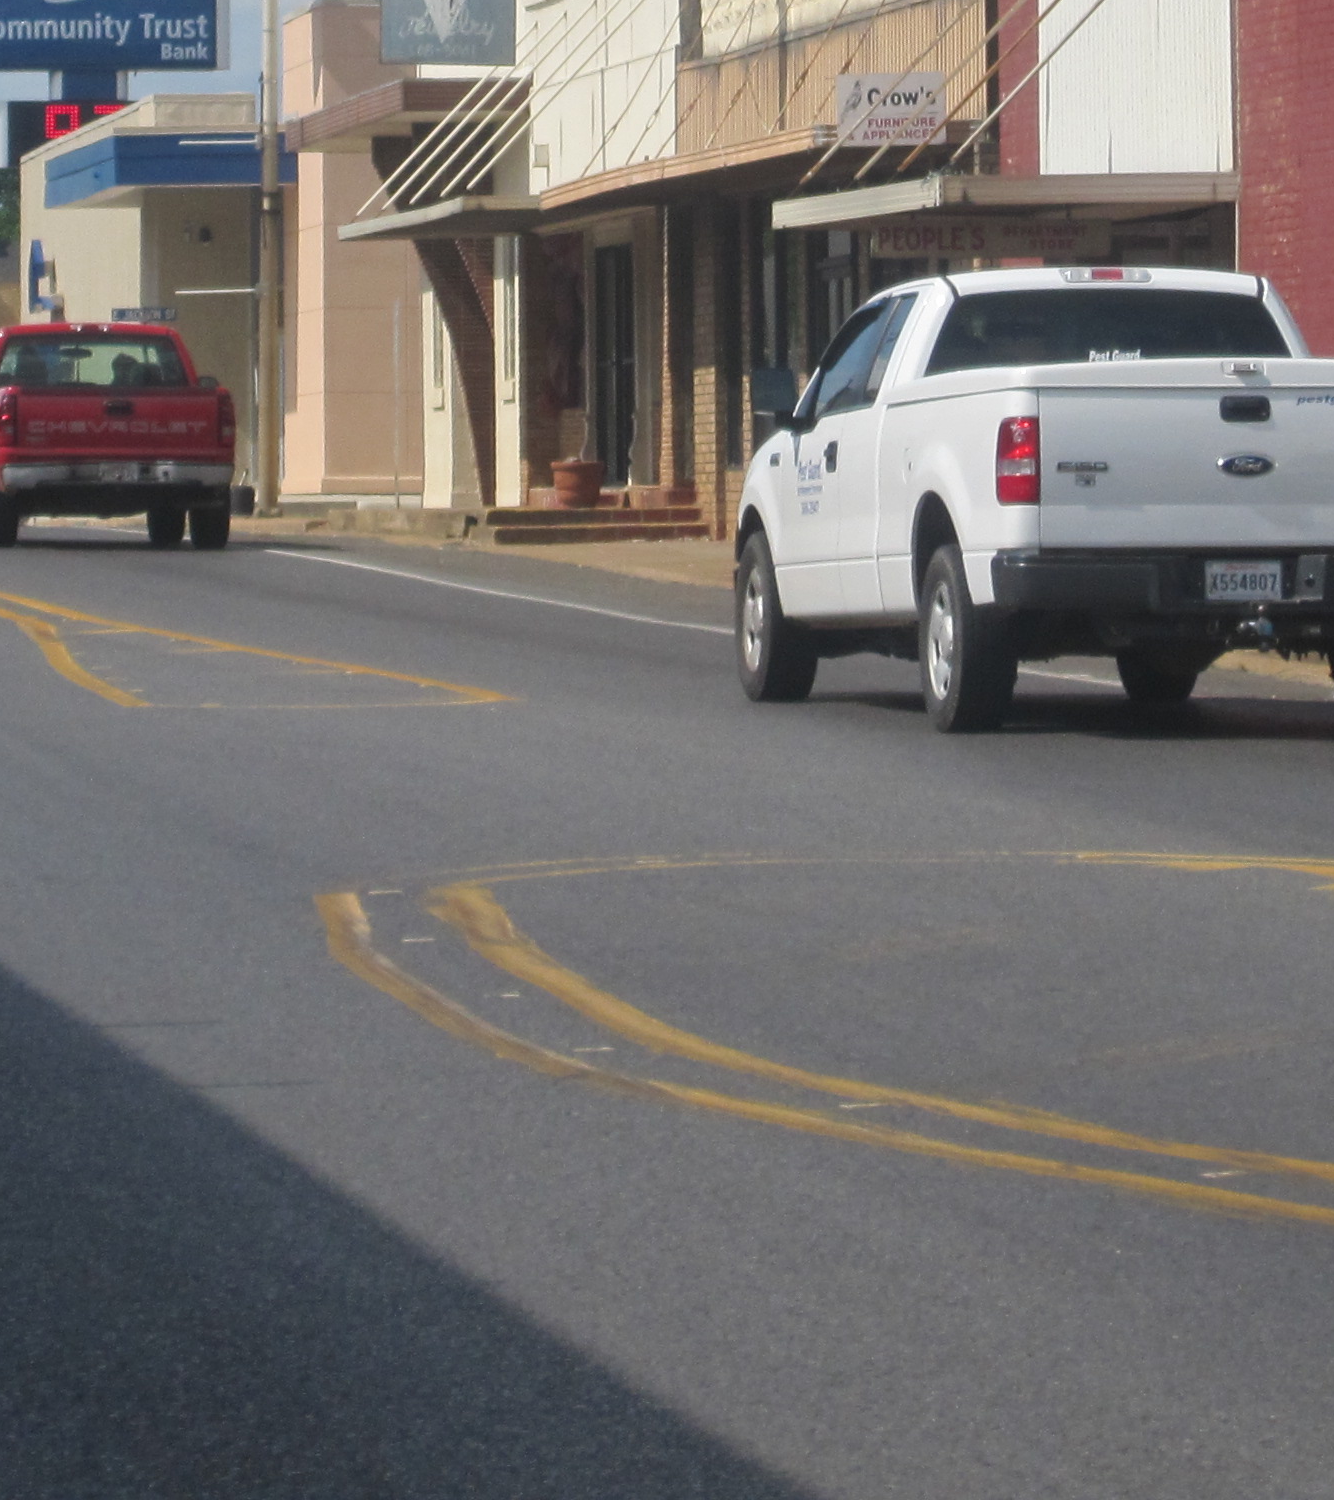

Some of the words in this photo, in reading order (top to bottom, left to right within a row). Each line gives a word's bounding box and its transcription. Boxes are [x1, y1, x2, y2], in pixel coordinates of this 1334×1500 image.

[139, 13, 209, 39] Trust
[160, 43, 208, 60] Bank
[1089, 351, 1109, 362] Pest
[1112, 349, 1141, 361] Guard
[28, 421, 207, 434] CHEVROLET
